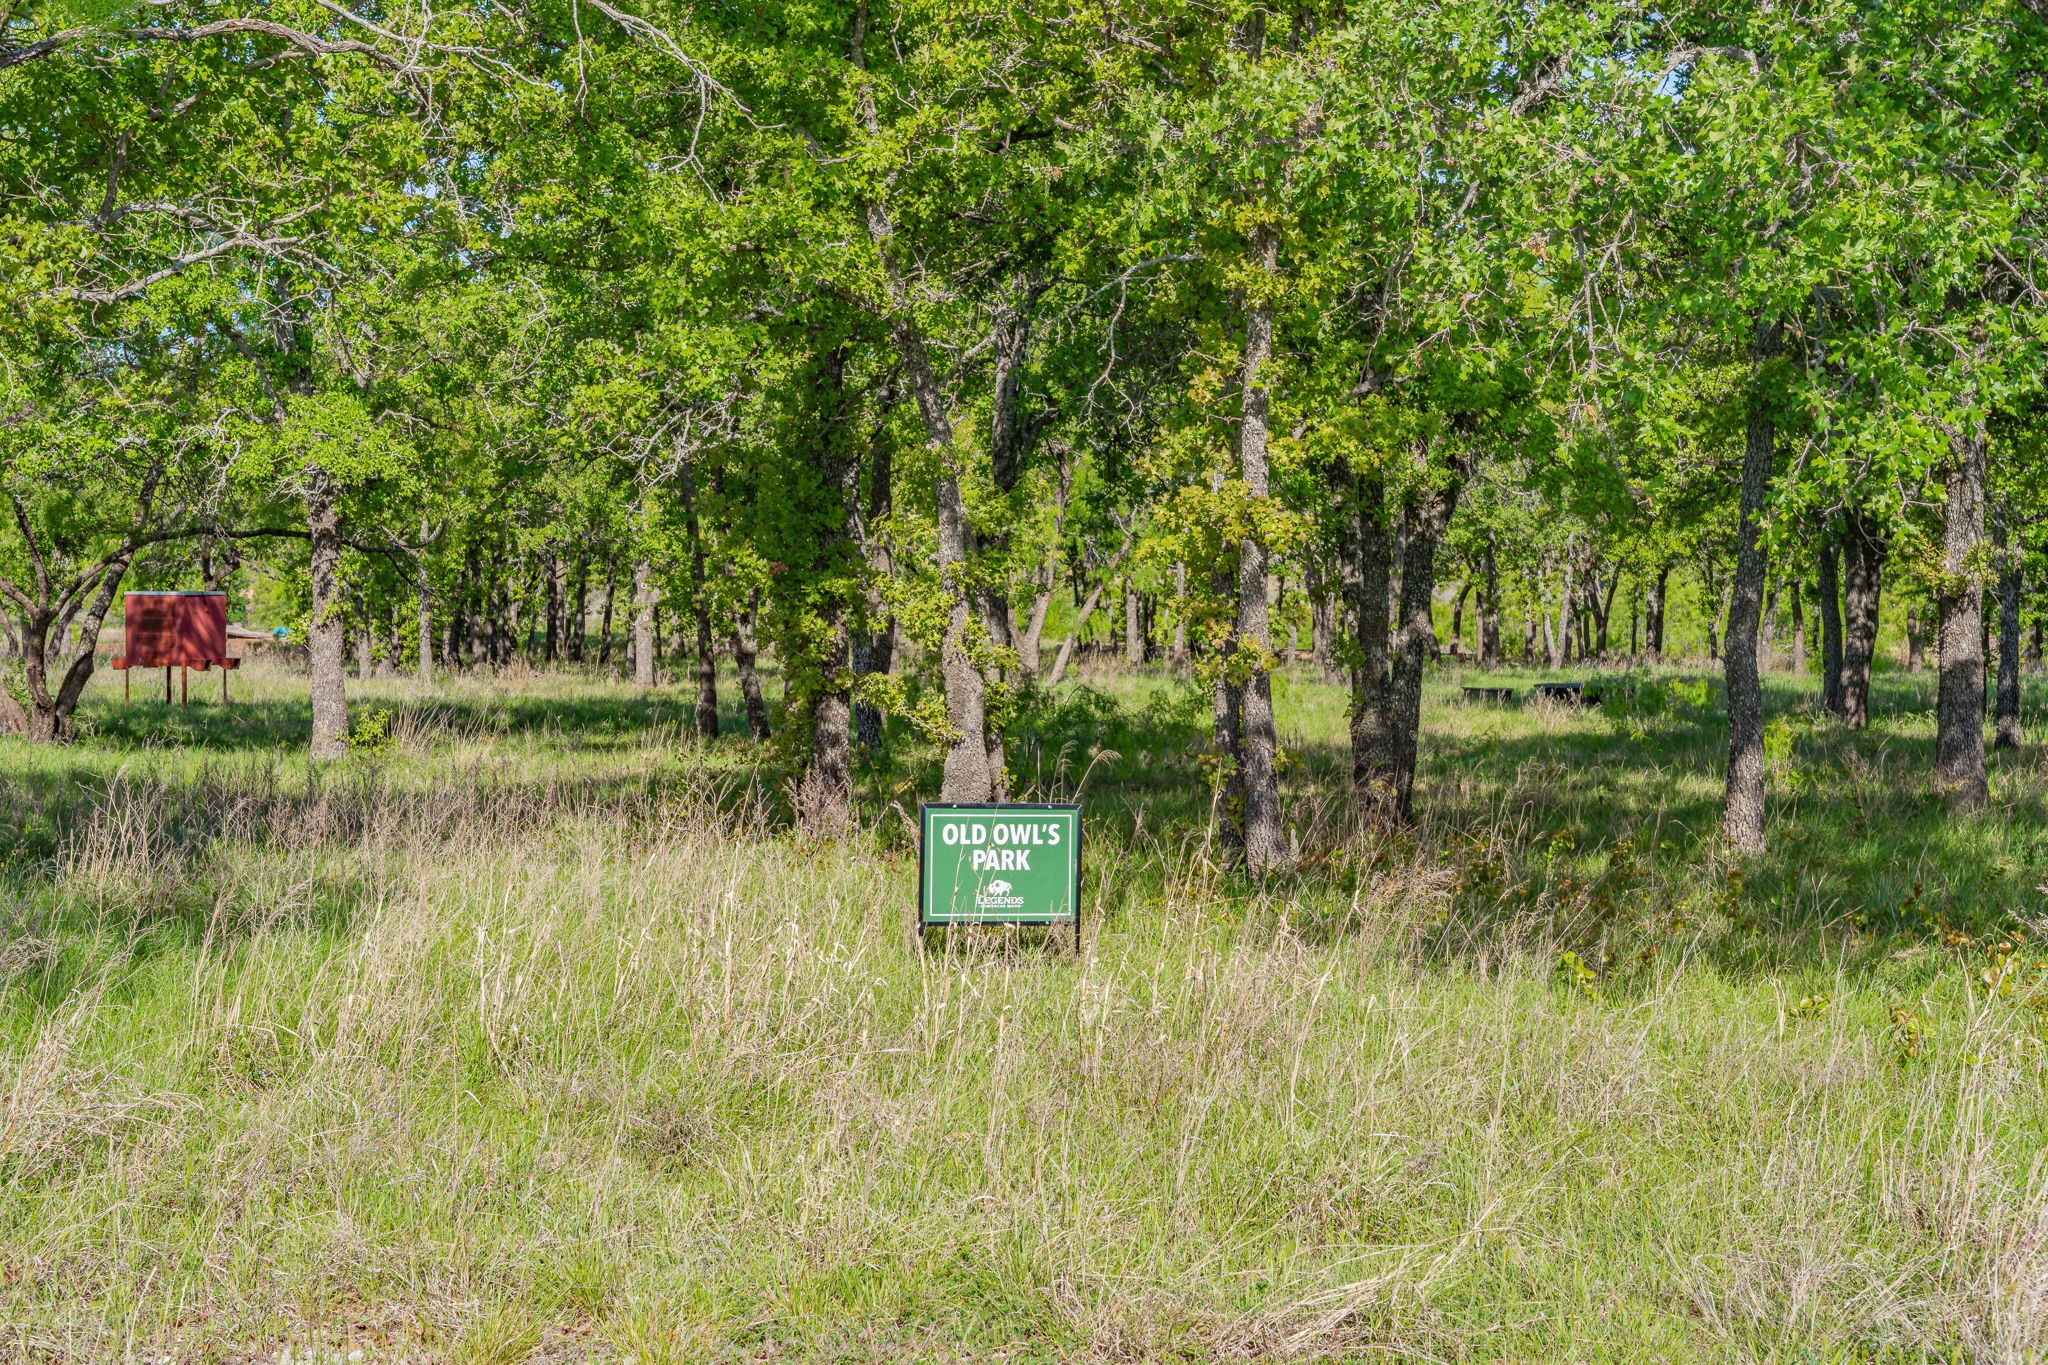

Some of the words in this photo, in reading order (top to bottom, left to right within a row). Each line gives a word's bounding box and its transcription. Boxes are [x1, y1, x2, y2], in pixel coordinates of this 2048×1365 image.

[942, 823, 987, 845] OLD
[993, 823, 1061, 845] OWL'S
[972, 849, 1031, 871] PARK
[977, 896, 1024, 905] LEGENDS
